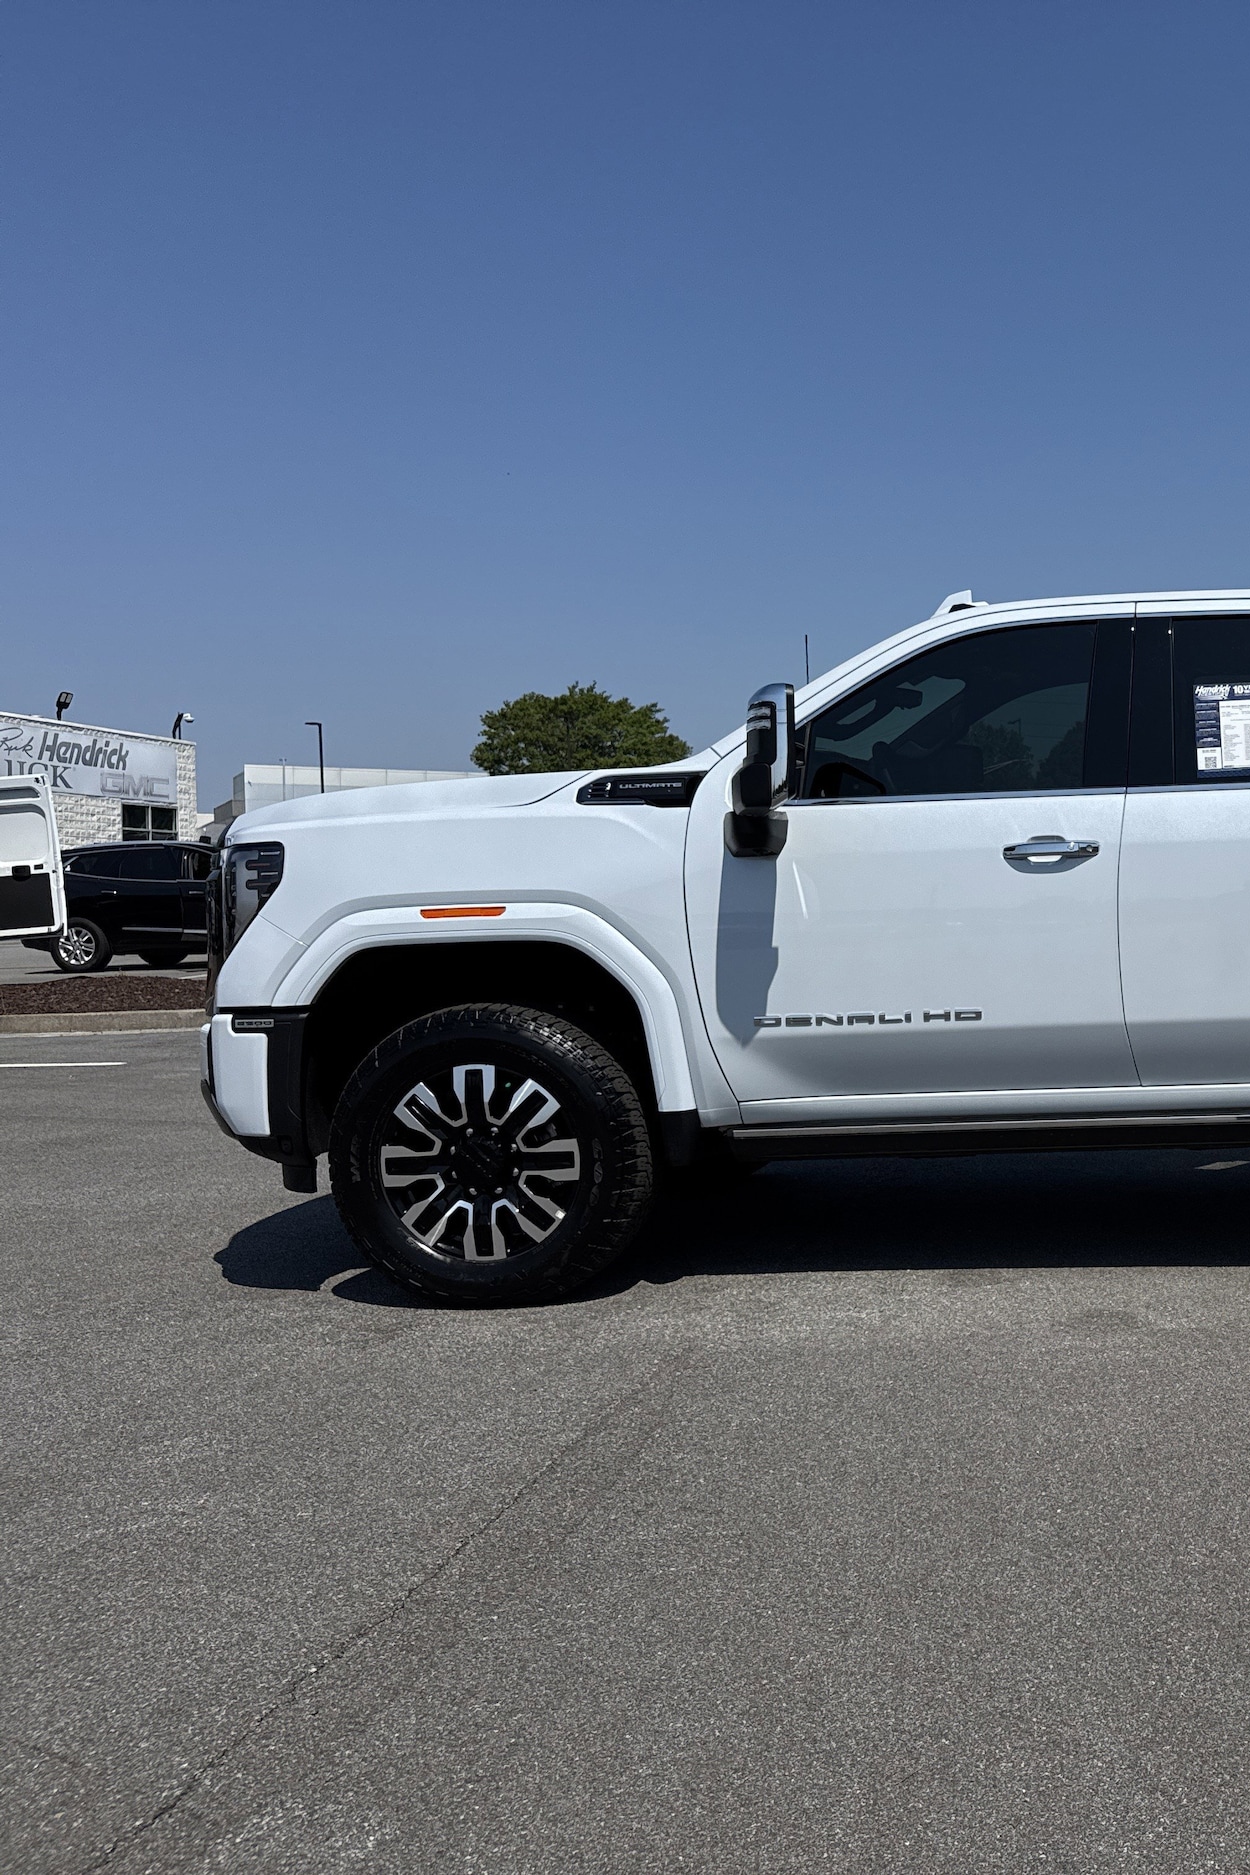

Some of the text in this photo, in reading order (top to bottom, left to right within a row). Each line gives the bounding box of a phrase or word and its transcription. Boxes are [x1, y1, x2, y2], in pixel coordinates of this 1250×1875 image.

[1232, 685, 1243, 694] 10
[38, 731, 130, 771] Hendrick
[100, 771, 170, 799] GMC
[753, 1007, 983, 1028] DENALI HD
